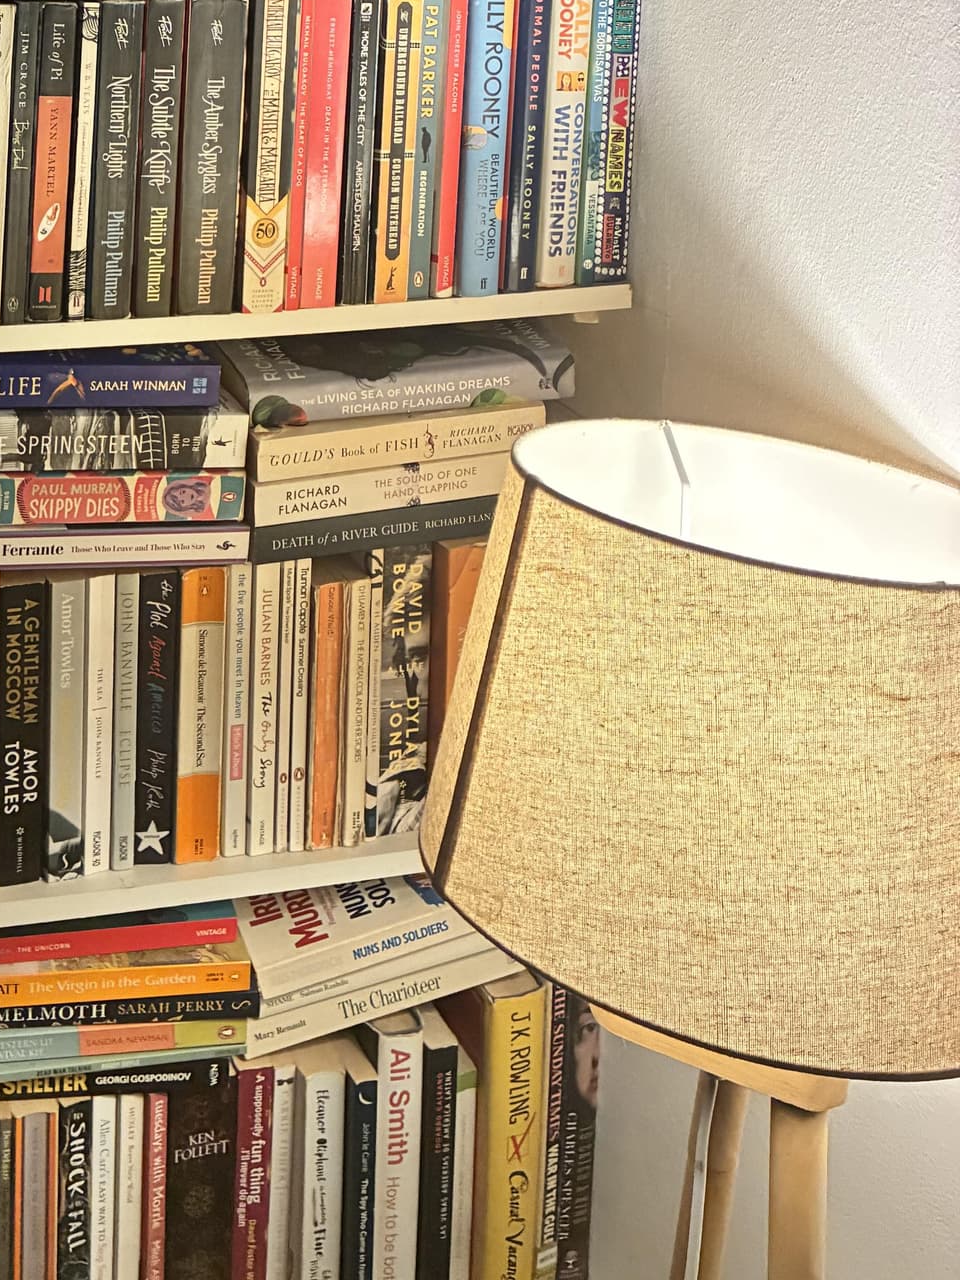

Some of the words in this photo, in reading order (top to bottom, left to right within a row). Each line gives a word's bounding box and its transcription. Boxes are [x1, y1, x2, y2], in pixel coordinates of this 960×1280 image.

[425, 5, 438, 40] PAT
[421, 44, 435, 119] BARKER
[482, 41, 504, 140] ROONEY
[529, 54, 542, 112] PEOPLE
[551, 104, 572, 161] WITH
[417, 170, 427, 238] REGENERATION
[548, 168, 568, 258] FRIENDS
[146, 207, 168, 244] Philip
[146, 246, 166, 303] Pullman
[89, 380, 129, 392] SARAH
[132, 380, 186, 392] WINMAN
[342, 400, 399, 415] RICHARD
[402, 393, 471, 409] FLANAGAN
[29, 496, 81, 520] SKIPPY
[85, 497, 120, 517] DIES
[278, 496, 347, 516] FLANAGAN
[285, 484, 340, 501] RICHARD
[2, 543, 64, 557] Ferrante
[272, 535, 315, 550] DEATH
[318, 532, 330, 545] of
[331, 535, 338, 543] a
[341, 527, 378, 541] RIVER
[381, 521, 419, 536] GUIDE
[117, 1001, 171, 1016] SARAH
[176, 999, 225, 1014] PERRY
[338, 996, 367, 1020] The
[369, 975, 443, 1011] Charioteer
[390, 1047, 410, 1086] Ali
[189, 1130, 215, 1146] KEN
[387, 1090, 411, 1166] Smith
[174, 1139, 231, 1163] FOLLETT
